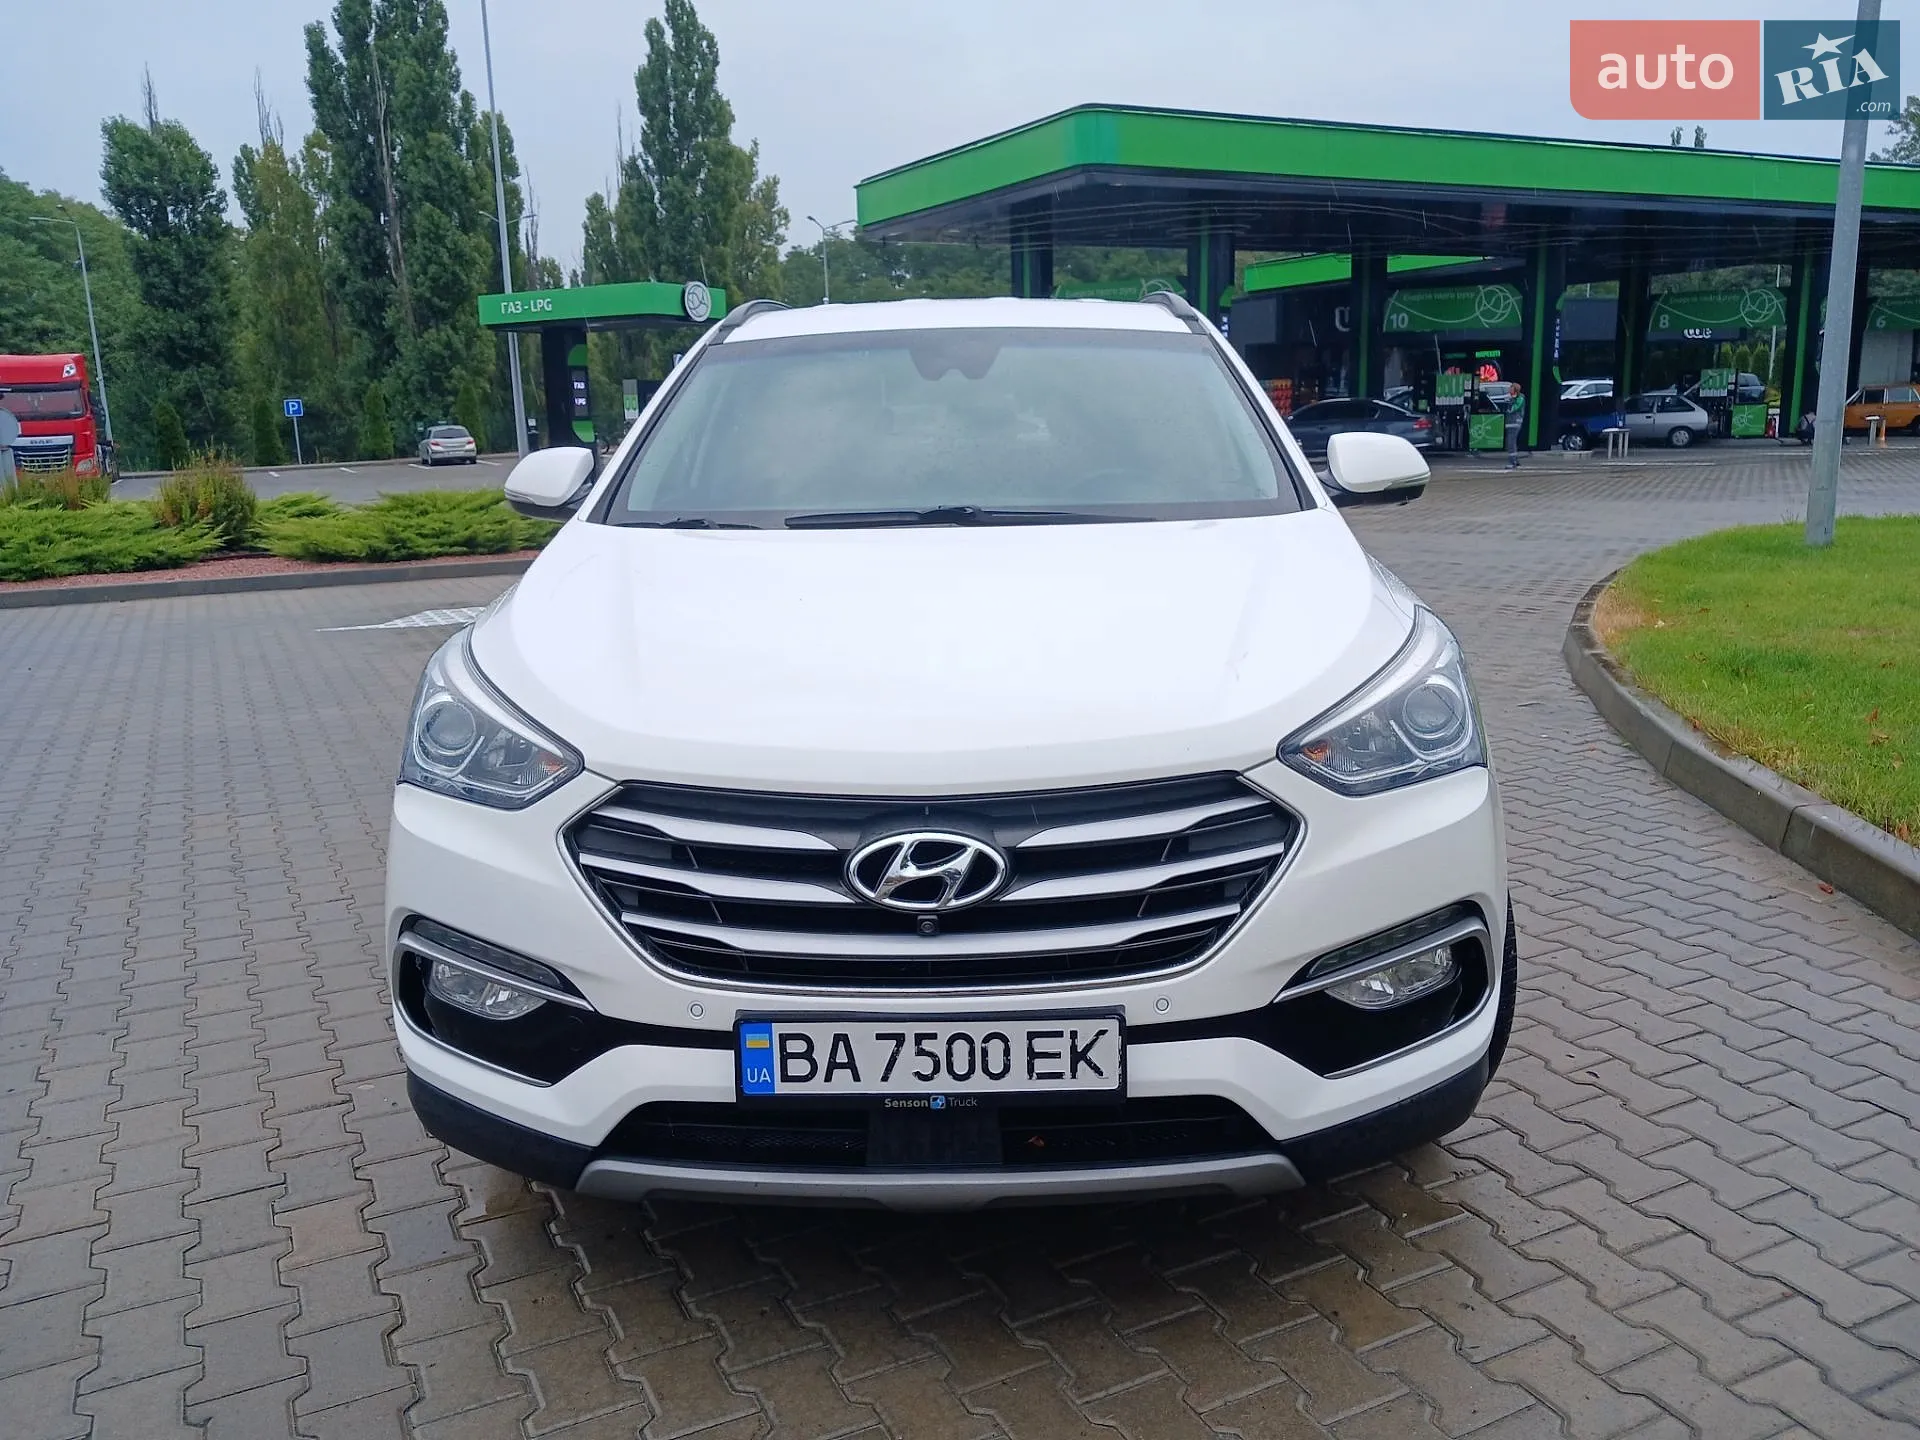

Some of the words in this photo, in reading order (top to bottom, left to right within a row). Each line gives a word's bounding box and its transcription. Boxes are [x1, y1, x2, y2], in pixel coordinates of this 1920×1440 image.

[1390, 312, 1409, 328] 10
[1659, 314, 1669, 329] 8
[1875, 315, 1887, 329] 6
[288, 402, 299, 415] P
[778, 1032, 861, 1083] BA
[875, 1031, 1011, 1082] 7500
[1026, 1029, 1109, 1079] EK
[747, 1068, 771, 1083] UA
[884, 1098, 928, 1108] Senson
[947, 1097, 978, 1107] Truck
